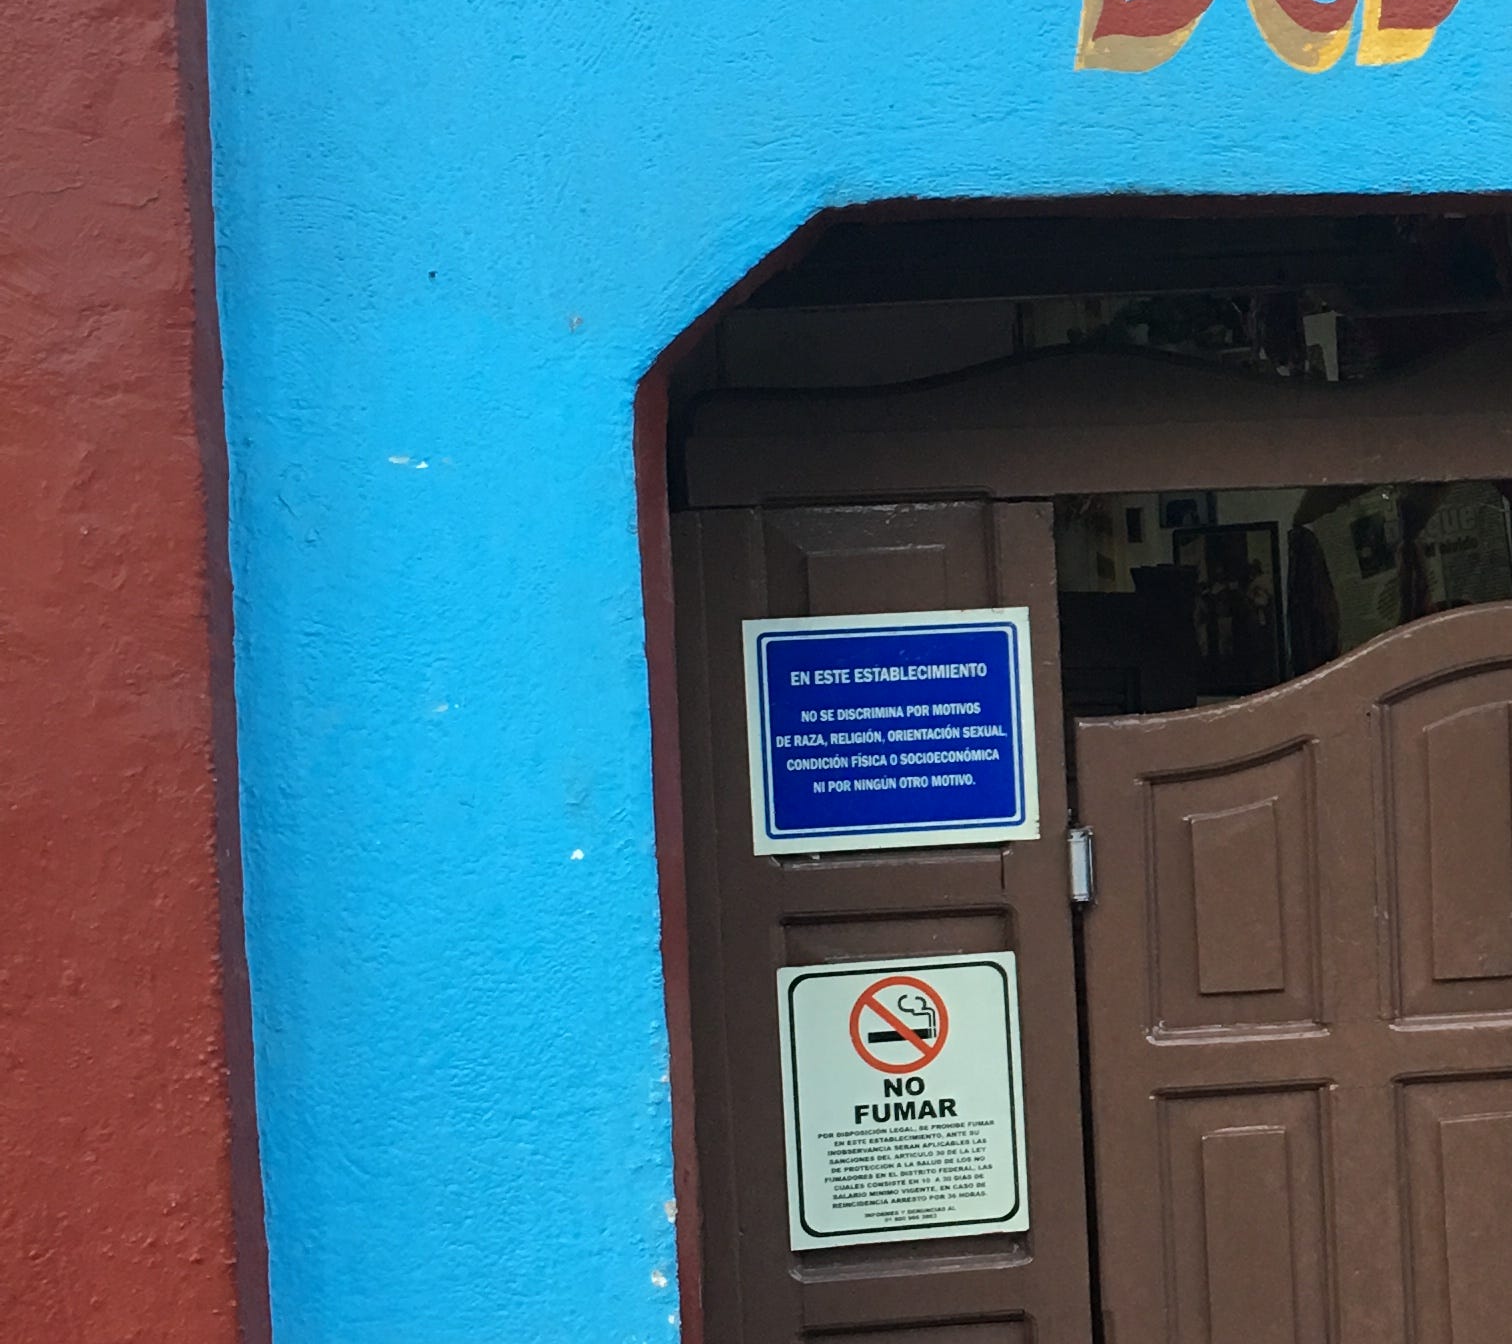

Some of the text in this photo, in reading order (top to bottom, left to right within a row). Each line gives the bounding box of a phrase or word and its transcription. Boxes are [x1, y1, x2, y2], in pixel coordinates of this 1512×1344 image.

[791, 663, 987, 686] EN ESTE ESTABLECIMIENTO
[801, 702, 981, 723] NO SE DISCRIMINA POR MOTIVOS
[776, 735, 792, 748] DE
[794, 734, 828, 747] RAZA,
[830, 728, 886, 745] RELIGIÓN,
[887, 724, 960, 742] ORIENTACIÓN
[787, 747, 1000, 771] CONDICIÓN FÍSICA O SOCIOECONÓMICA
[813, 774, 976, 793] NI POR NINGÚN OTRO MOTIVO.
[884, 1076, 925, 1098] NO
[854, 1098, 958, 1125] FUMAR
[829, 1155, 875, 1165] SANCIONES
[834, 1183, 865, 1191] CUALES
